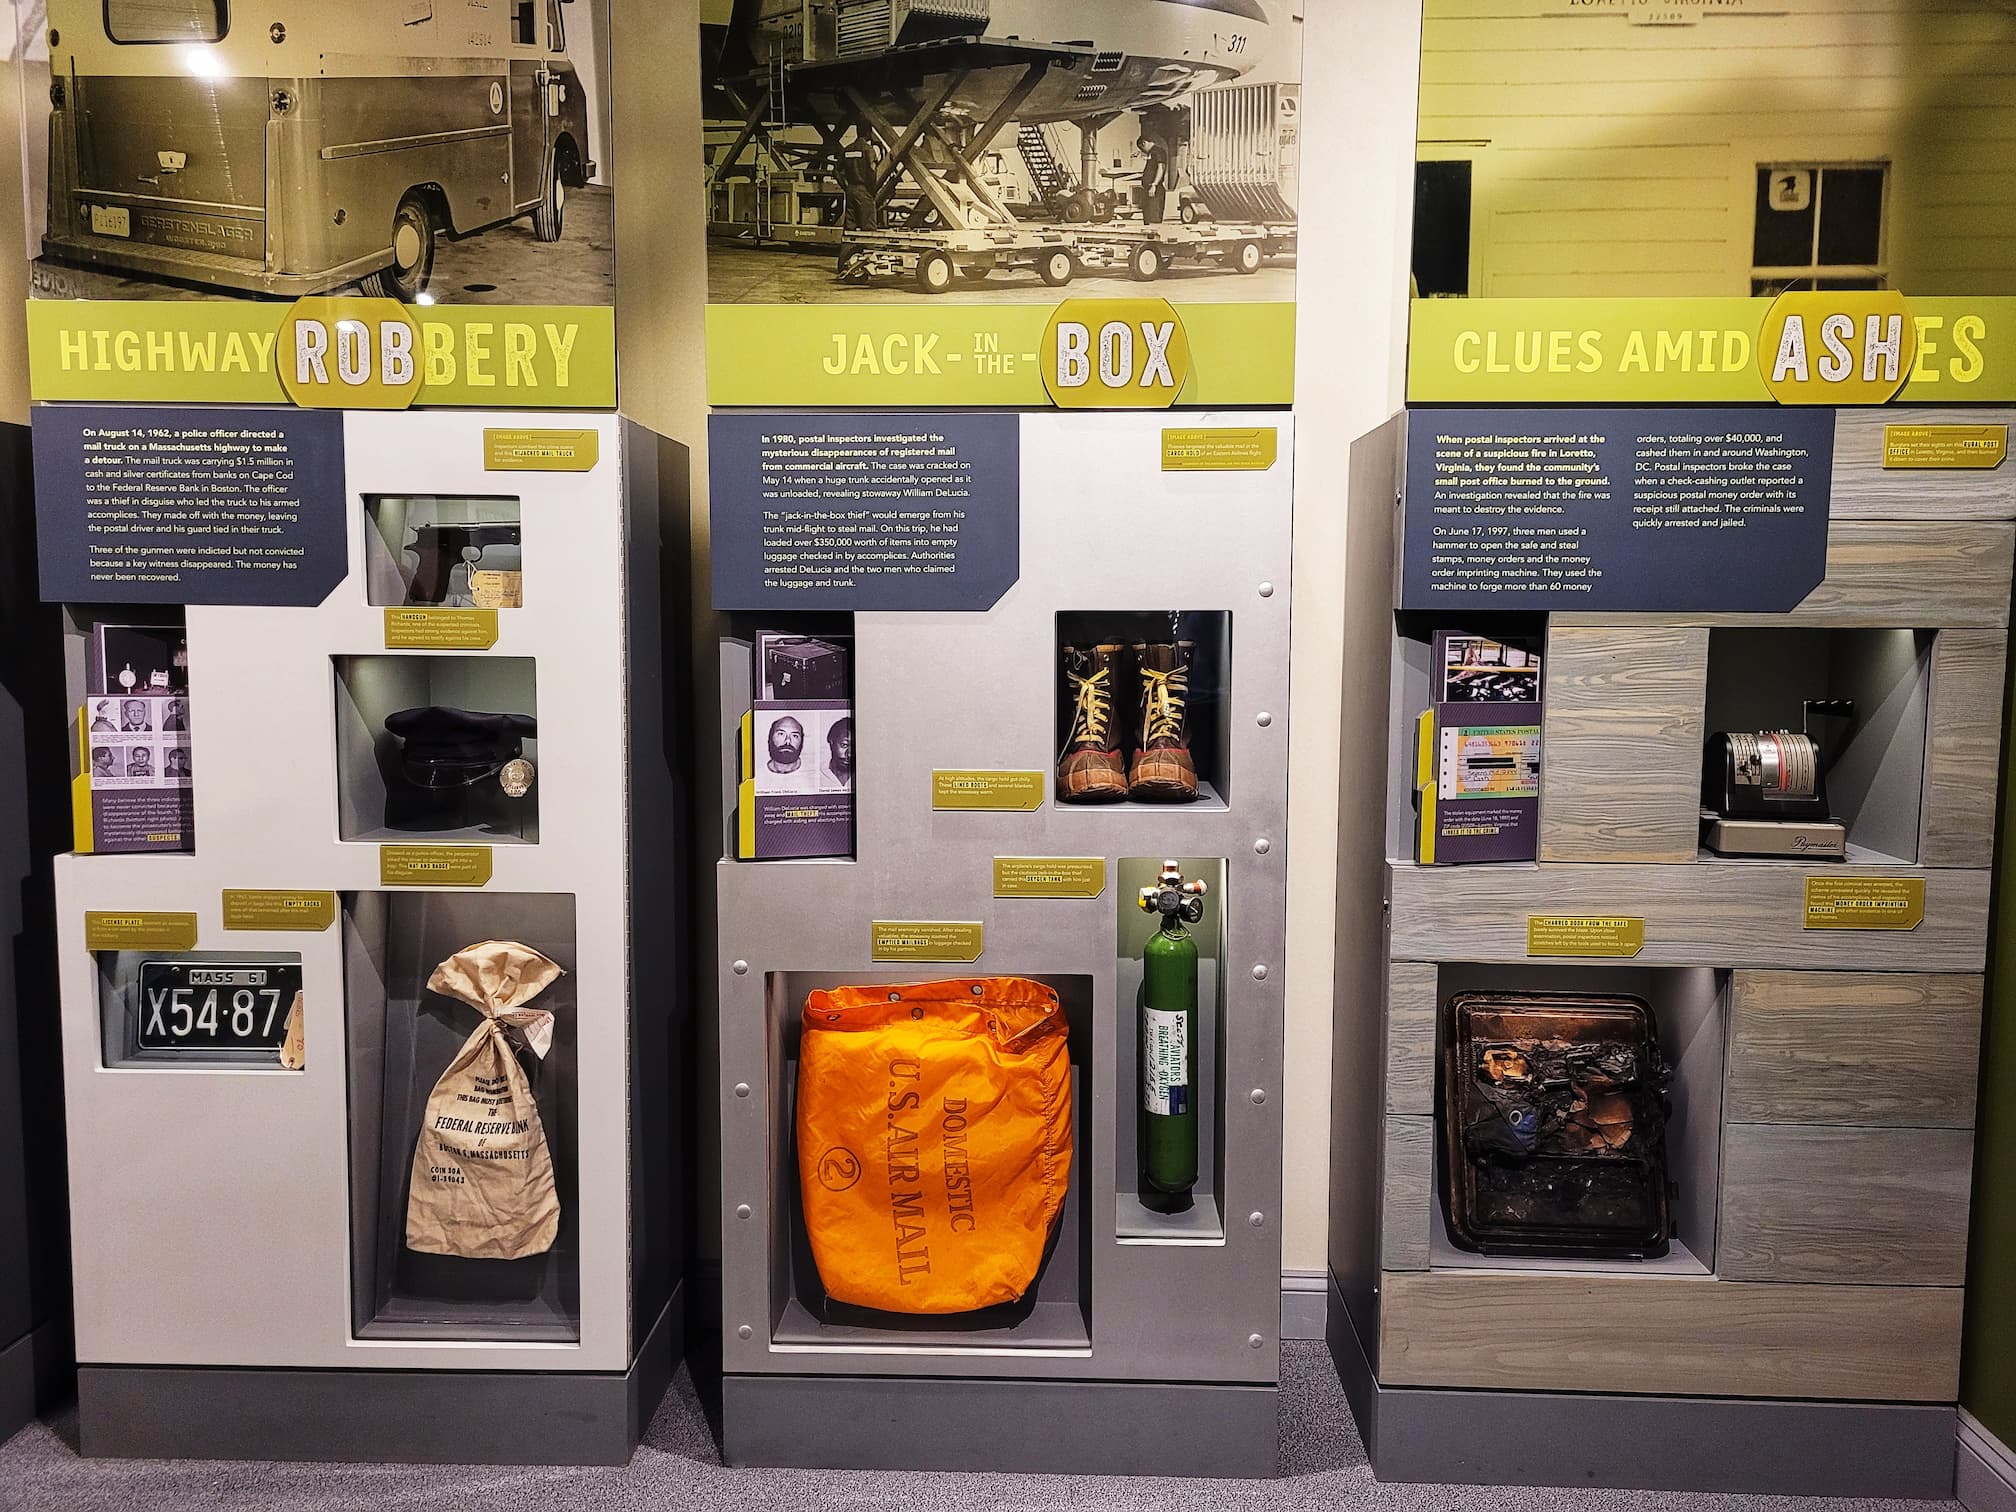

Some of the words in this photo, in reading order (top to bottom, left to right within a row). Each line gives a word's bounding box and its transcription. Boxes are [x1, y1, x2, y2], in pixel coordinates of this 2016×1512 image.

[1228, 34, 1247, 54] 311
[60, 329, 275, 374] HIGHWAY
[1453, 330, 1603, 374] CLUES
[1619, 330, 1750, 373] AMID
[1772, 313, 1986, 384] ASHES
[974, 332, 999, 353] IN
[1056, 321, 1175, 388] BOX
[83, 429, 96, 437] On
[98, 429, 129, 439] August
[131, 430, 145, 439] 14,
[148, 430, 172, 439] 1962,
[182, 430, 208, 440] police
[210, 430, 238, 438] officer
[762, 435, 770, 443] In
[773, 435, 796, 445] 1980,
[799, 435, 825, 444] postal
[827, 435, 871, 444] inspectors
[874, 434, 927, 444] investigated
[929, 434, 944, 442] the
[1437, 435, 1462, 443] When
[1465, 435, 1492, 445] postal
[1495, 435, 1541, 445] inspectors
[1543, 435, 1576, 443] arrived
[1578, 435, 1588, 443] at
[1637, 434, 1667, 445] orders,
[1669, 434, 1702, 445] totaling
[1726, 434, 1763, 444] $40,000,
[1765, 434, 1782, 442] and
[104, 443, 126, 451] truck
[149, 443, 211, 451] Massachusetts
[214, 443, 250, 453] highway
[253, 444, 262, 452] to
[264, 444, 287, 452] make
[762, 449, 809, 459] mysterious
[811, 448, 877, 458] disappearances
[879, 448, 889, 456] of
[891, 448, 935, 458] registered
[1464, 449, 1474, 457] of
[1483, 449, 1529, 459] suspicious
[1531, 449, 1546, 457] fire
[1549, 449, 1557, 457] in
[1560, 449, 1596, 459] Loretto,
[92, 456, 123, 464] detour.
[202, 457, 234, 467] carrying
[236, 457, 254, 467] $1.5
[762, 462, 782, 470] from
[785, 462, 833, 470] commercial
[835, 462, 869, 470] aircraft.
[871, 462, 886, 470] The
[927, 461, 957, 469] cracked
[1436, 464, 1472, 473] Virginia,
[1475, 464, 1495, 473] they
[1497, 463, 1524, 471] found
[1526, 463, 1541, 471] the
[1460, 478, 1480, 487] post
[1545, 477, 1555, 485] to
[1558, 477, 1572, 485] the
[1575, 477, 1610, 487] ground.
[1792, 835, 1838, 852] Paymaster
[191, 973, 233, 983] MASS
[248, 973, 265, 983] 61
[1158, 1025, 1169, 1066] BREATHING
[1170, 1044, 1181, 1082] AVIATORS
[468, 1095, 480, 1103] BAG
[435, 1116, 473, 1132] FEDERAL
[475, 1119, 511, 1135] RESERVE
[887, 1122, 919, 1185] AIR
[430, 1166, 446, 1174] COIN
[823, 1158, 856, 1181] 2
[942, 1096, 975, 1233] DOMESTIC
[891, 1191, 931, 1286] MAIL
